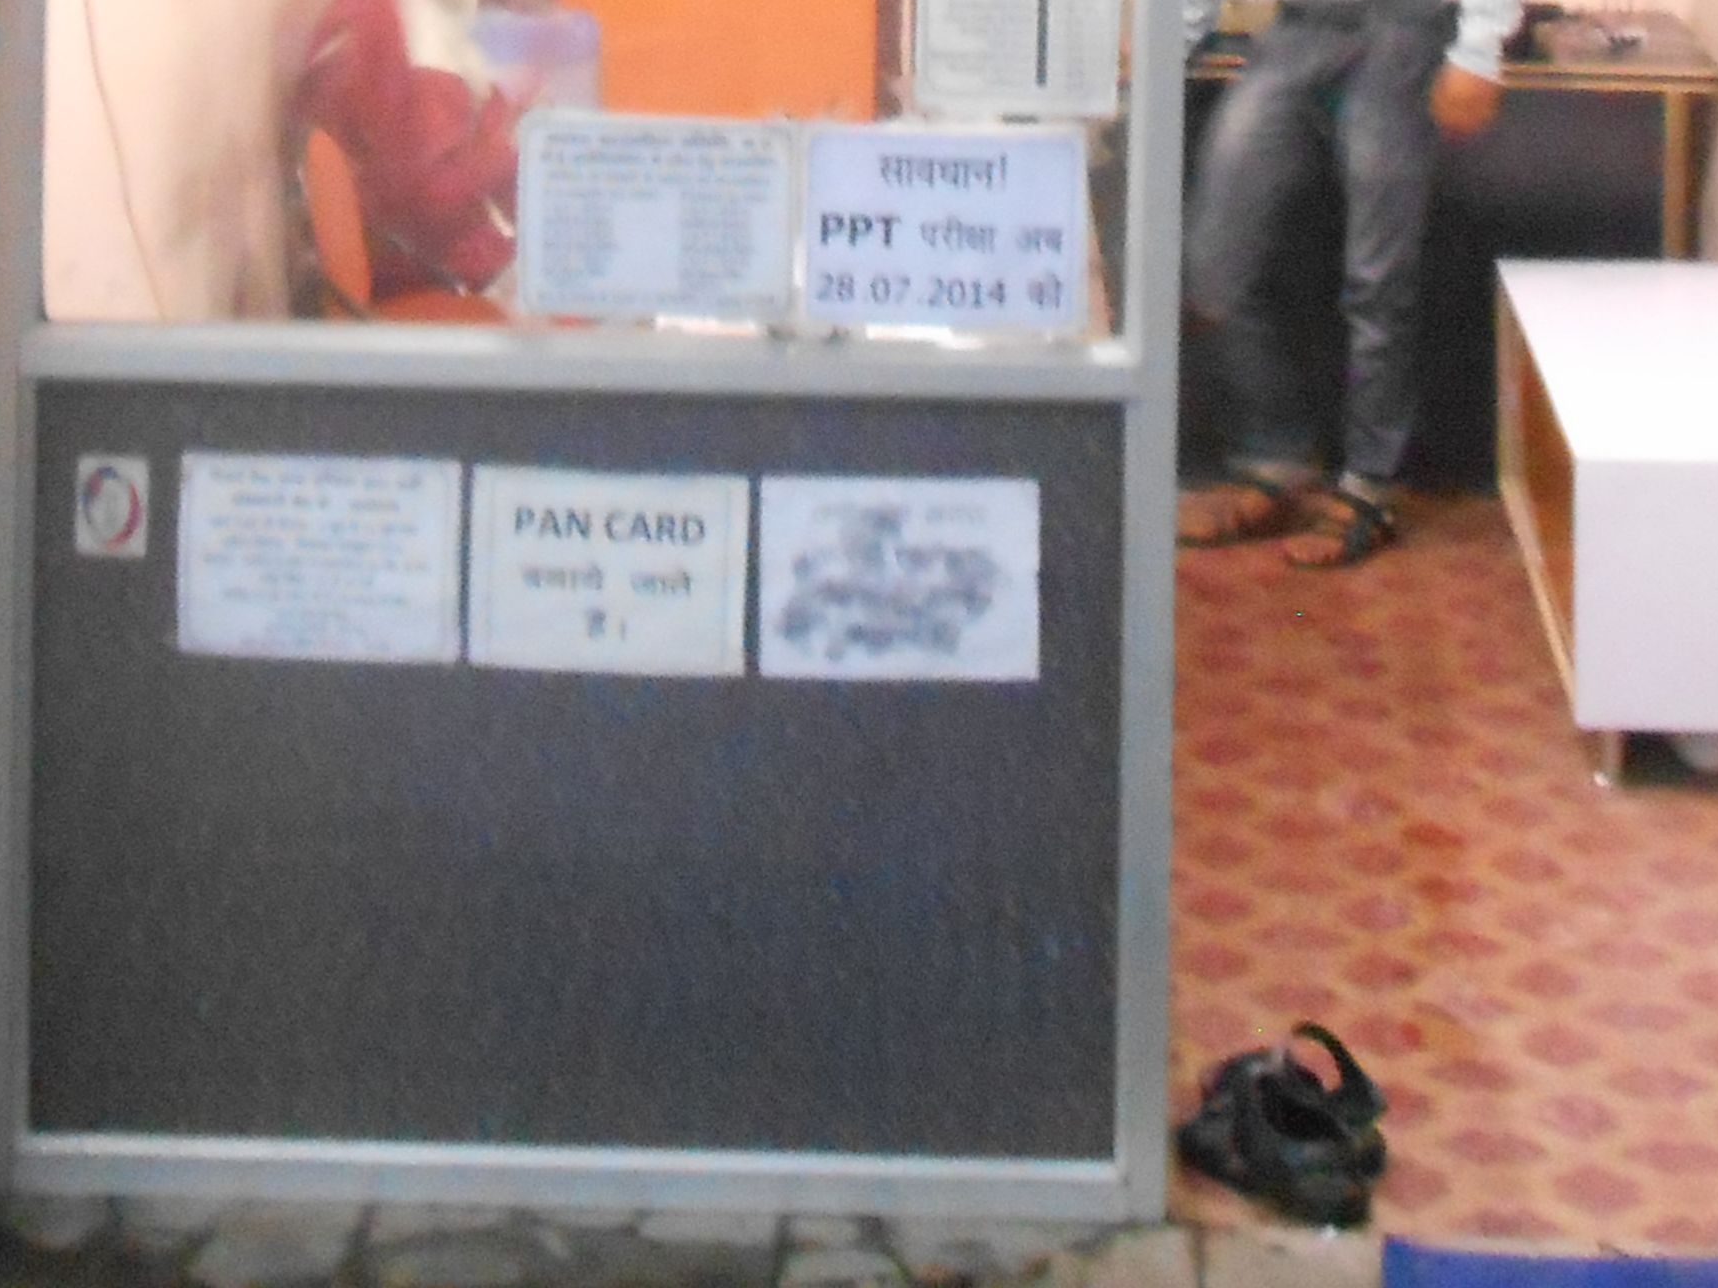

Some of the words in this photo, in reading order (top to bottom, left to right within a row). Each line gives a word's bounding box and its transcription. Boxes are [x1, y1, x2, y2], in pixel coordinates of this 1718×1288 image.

[820, 211, 900, 248] PPT
[514, 505, 591, 540] PAN
[604, 509, 706, 546] CARD
